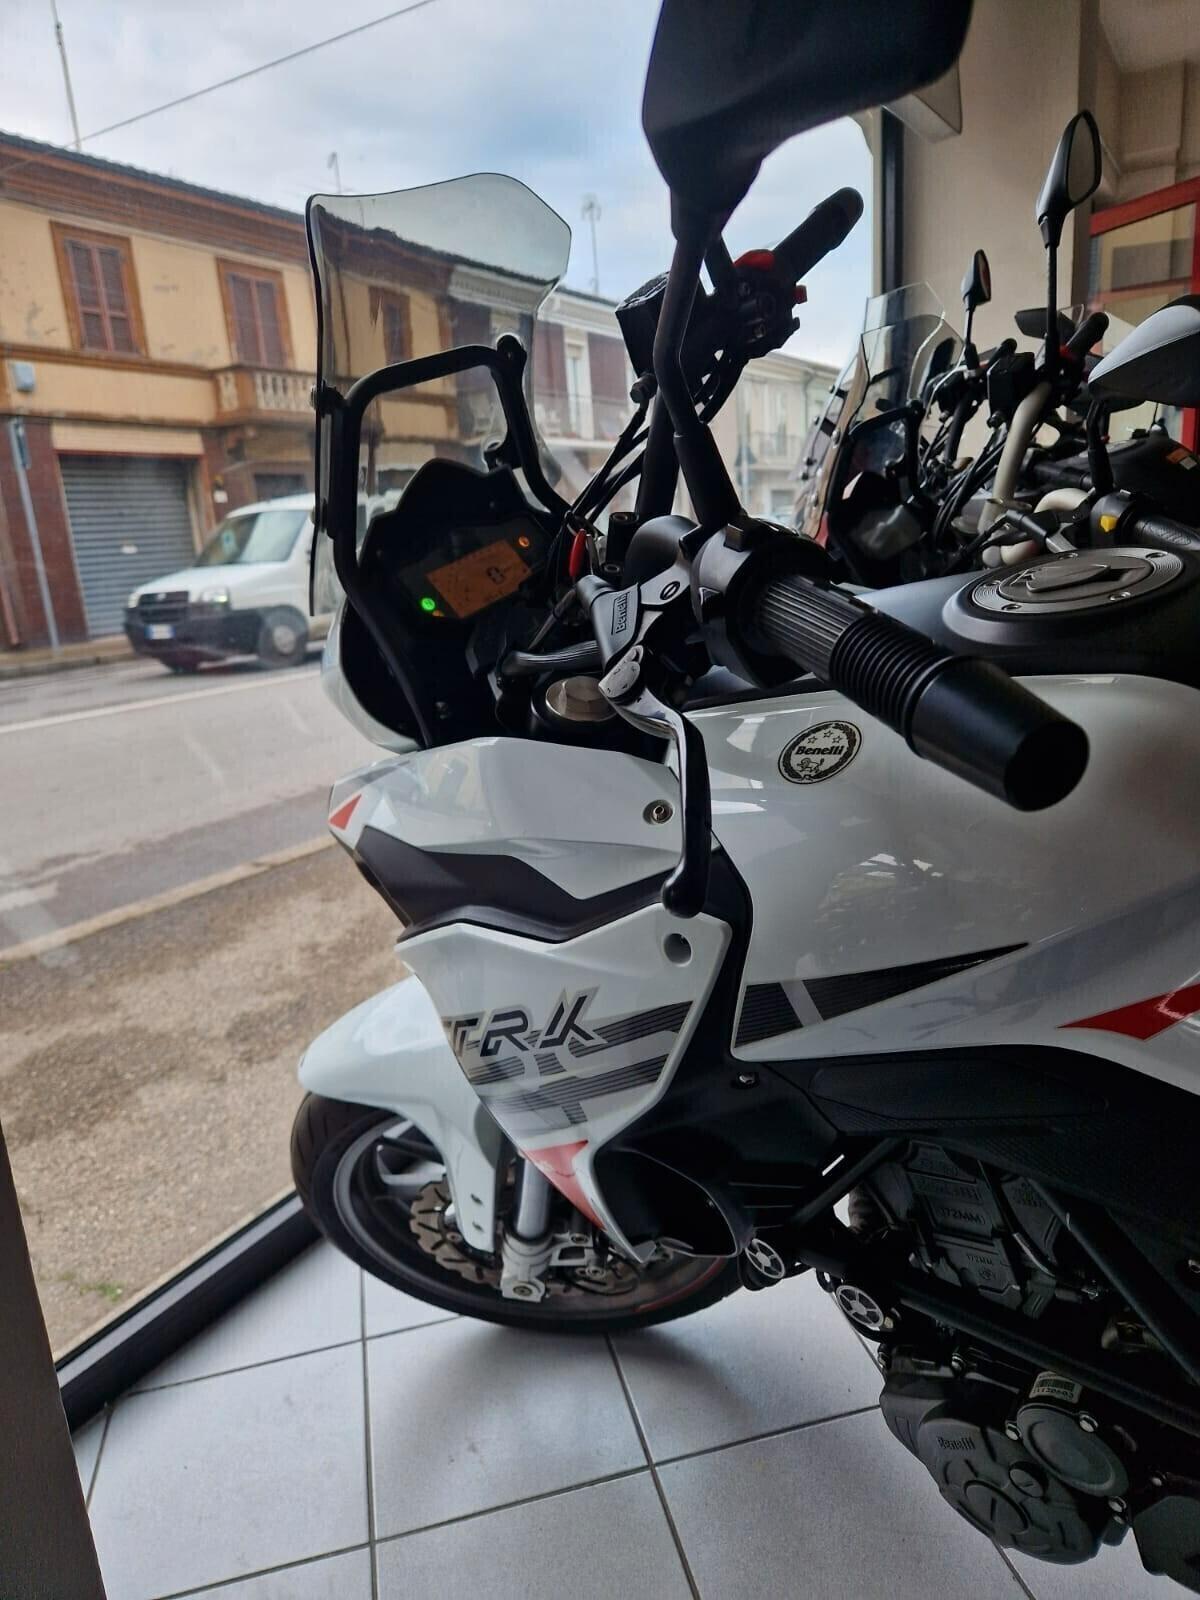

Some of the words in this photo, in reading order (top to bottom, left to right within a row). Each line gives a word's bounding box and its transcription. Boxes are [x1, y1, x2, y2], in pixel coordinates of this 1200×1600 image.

[616, 592, 629, 634] Benelli
[795, 745, 844, 755] Benelli
[442, 986, 606, 1058] TRK
